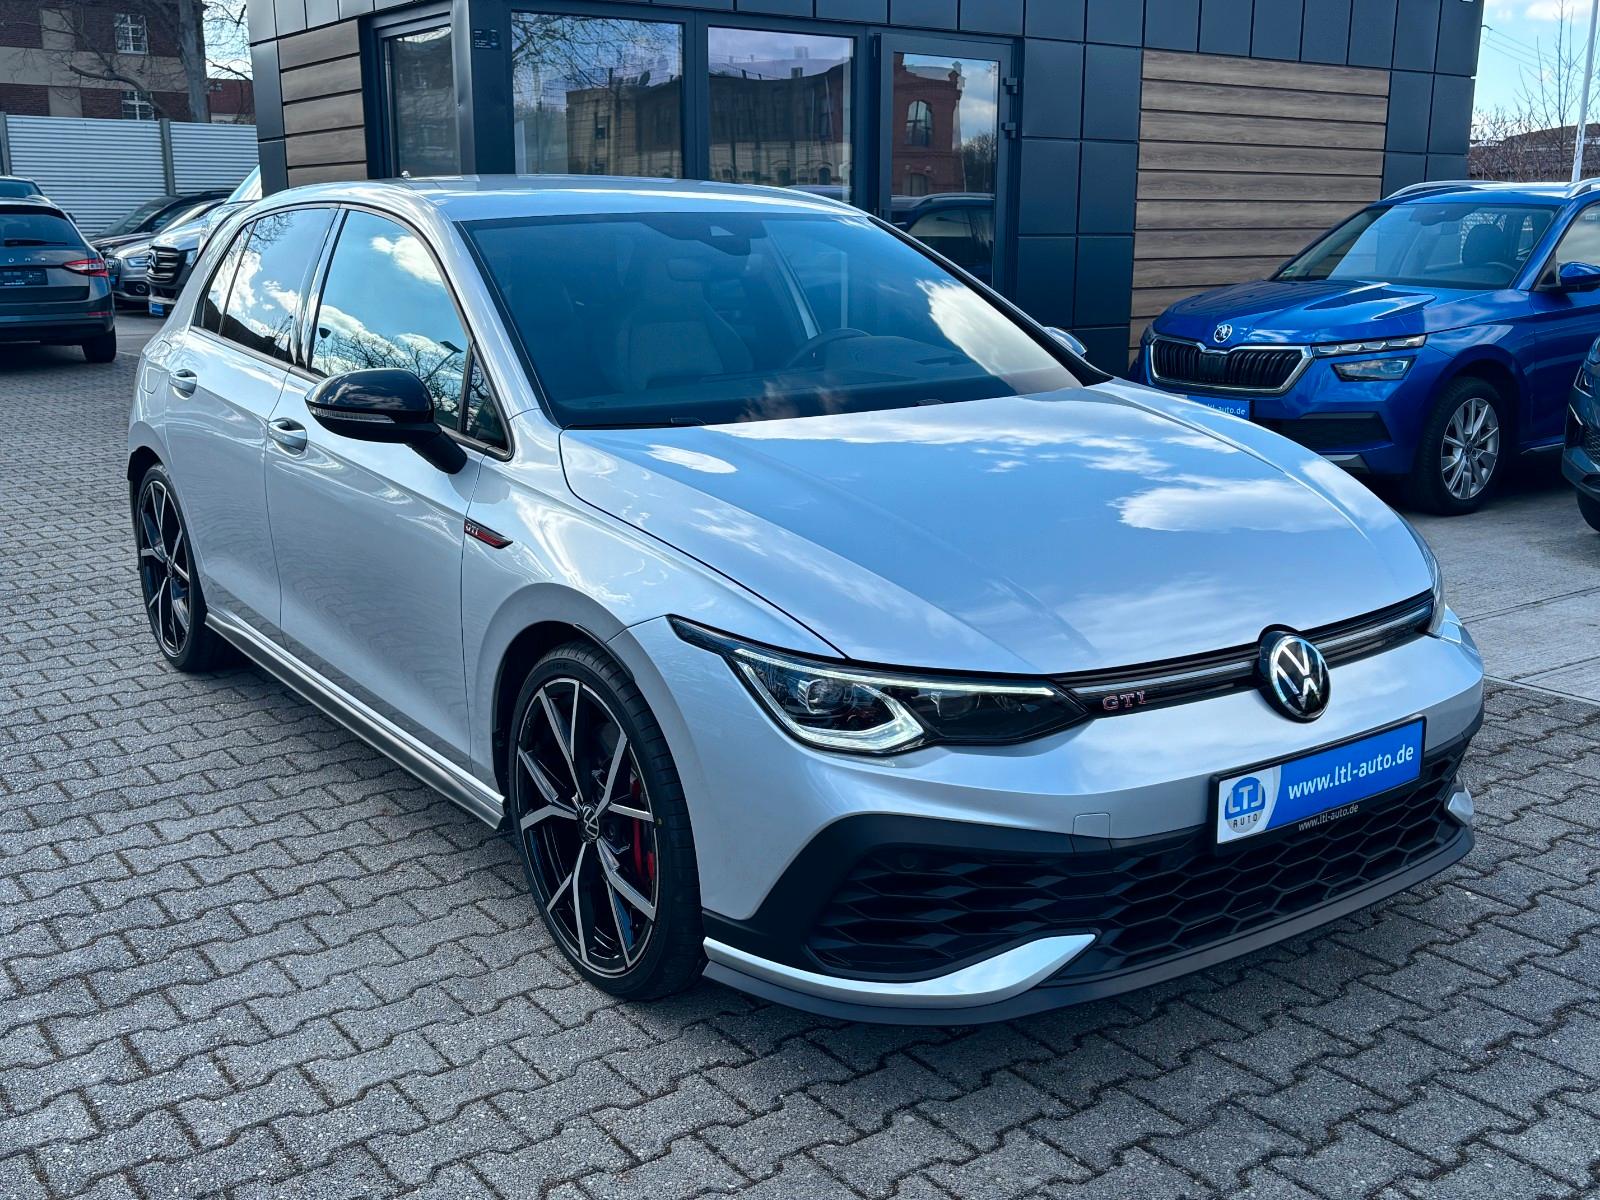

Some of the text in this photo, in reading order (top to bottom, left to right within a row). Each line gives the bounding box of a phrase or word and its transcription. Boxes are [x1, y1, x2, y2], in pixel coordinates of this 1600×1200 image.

[465, 523, 479, 536] GTI
[1103, 690, 1147, 711] GTI
[1288, 744, 1414, 800] www.ltl-auto.de
[1232, 813, 1258, 828] AUTO
[1298, 804, 1359, 831] www.ltl-auto.de
